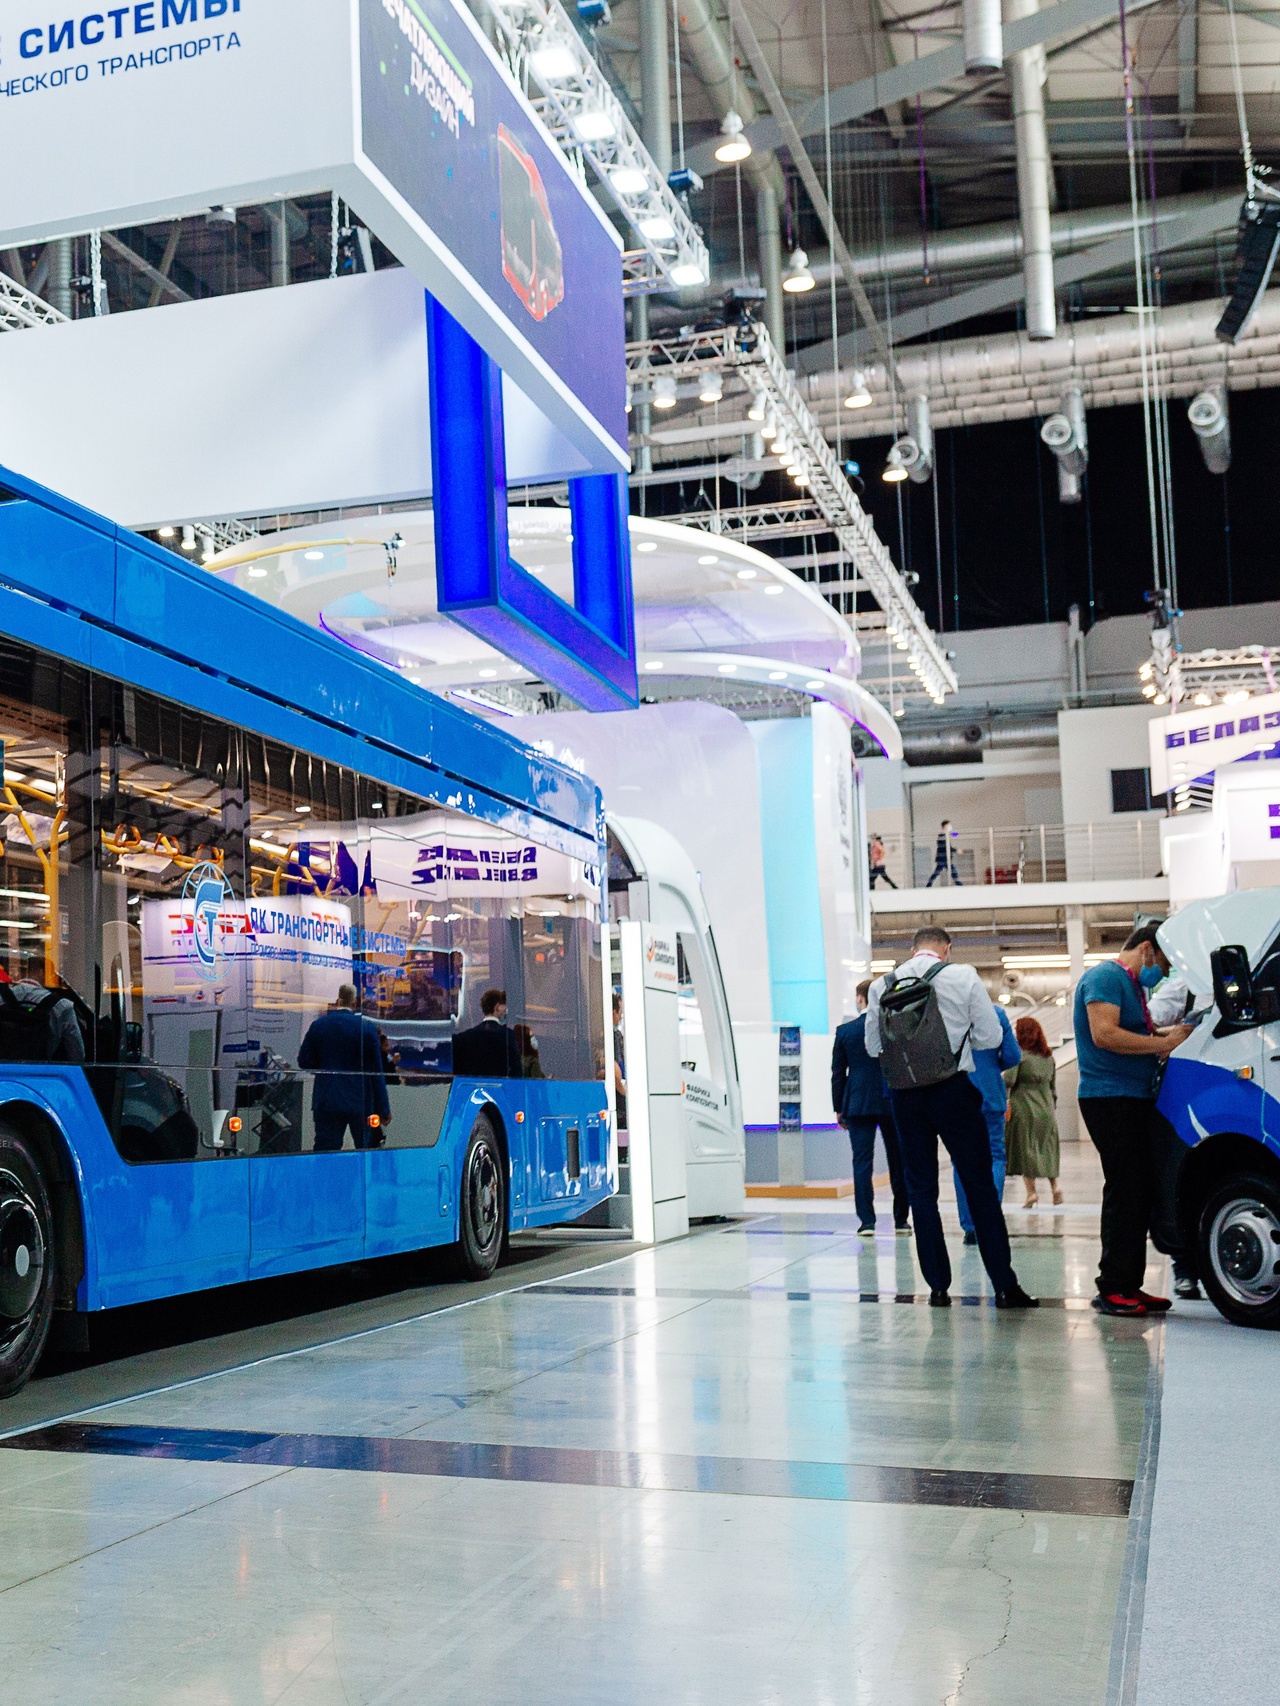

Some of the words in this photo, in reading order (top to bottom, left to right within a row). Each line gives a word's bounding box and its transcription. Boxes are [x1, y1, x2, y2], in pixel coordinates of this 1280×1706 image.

[98, 32, 242, 77] ТРАНСПОРТА
[251, 907, 267, 933] ПК
[271, 911, 358, 949] ТРАНСПОРТНЫЕ
[360, 929, 407, 957] СИСТЕМЫ
